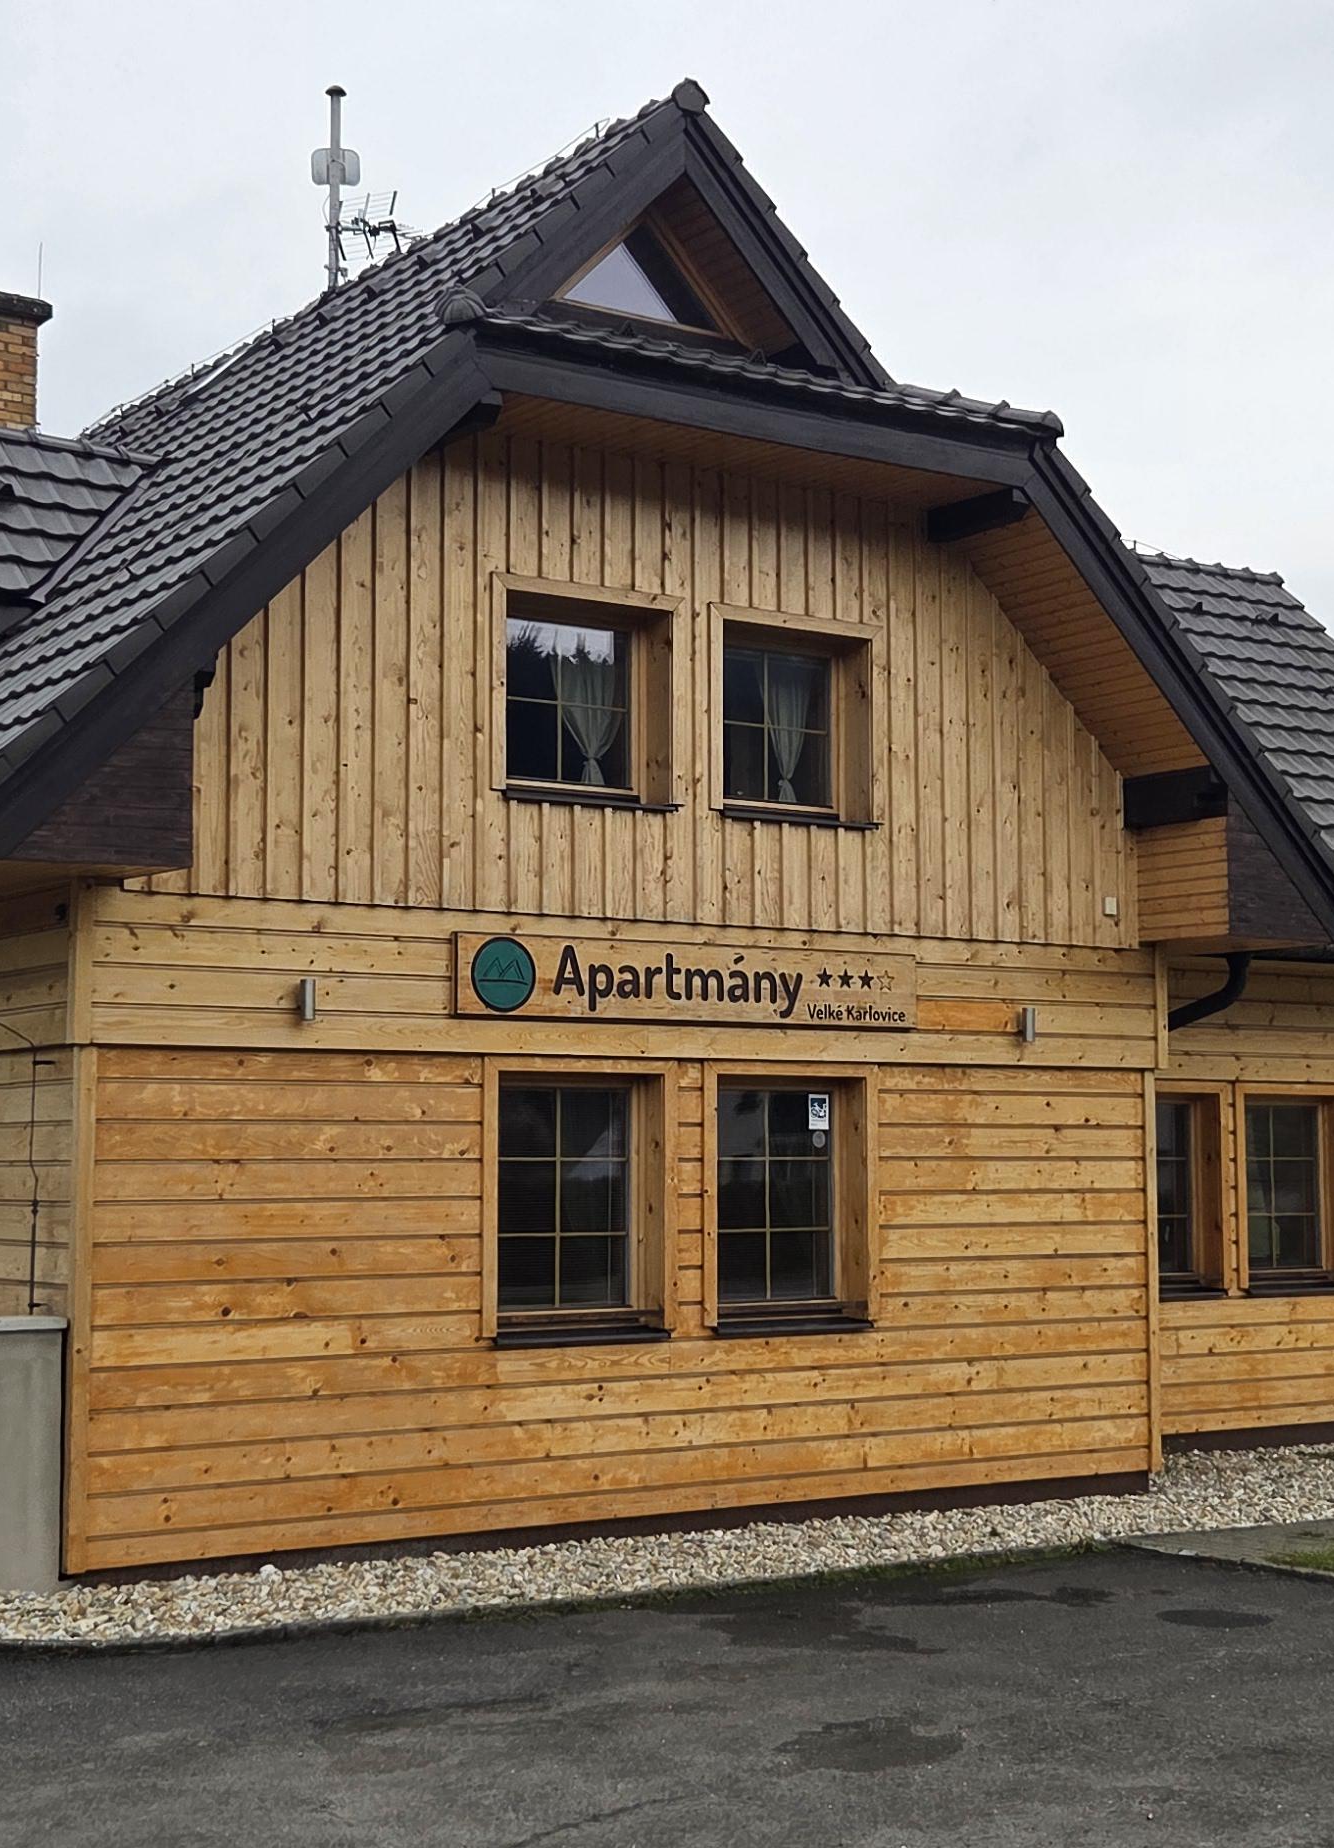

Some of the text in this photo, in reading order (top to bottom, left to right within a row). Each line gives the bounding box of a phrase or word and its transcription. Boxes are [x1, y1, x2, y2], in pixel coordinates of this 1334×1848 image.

[552, 944, 804, 1019] Apartmány
[807, 1003, 906, 1022] Velké Karlovice
